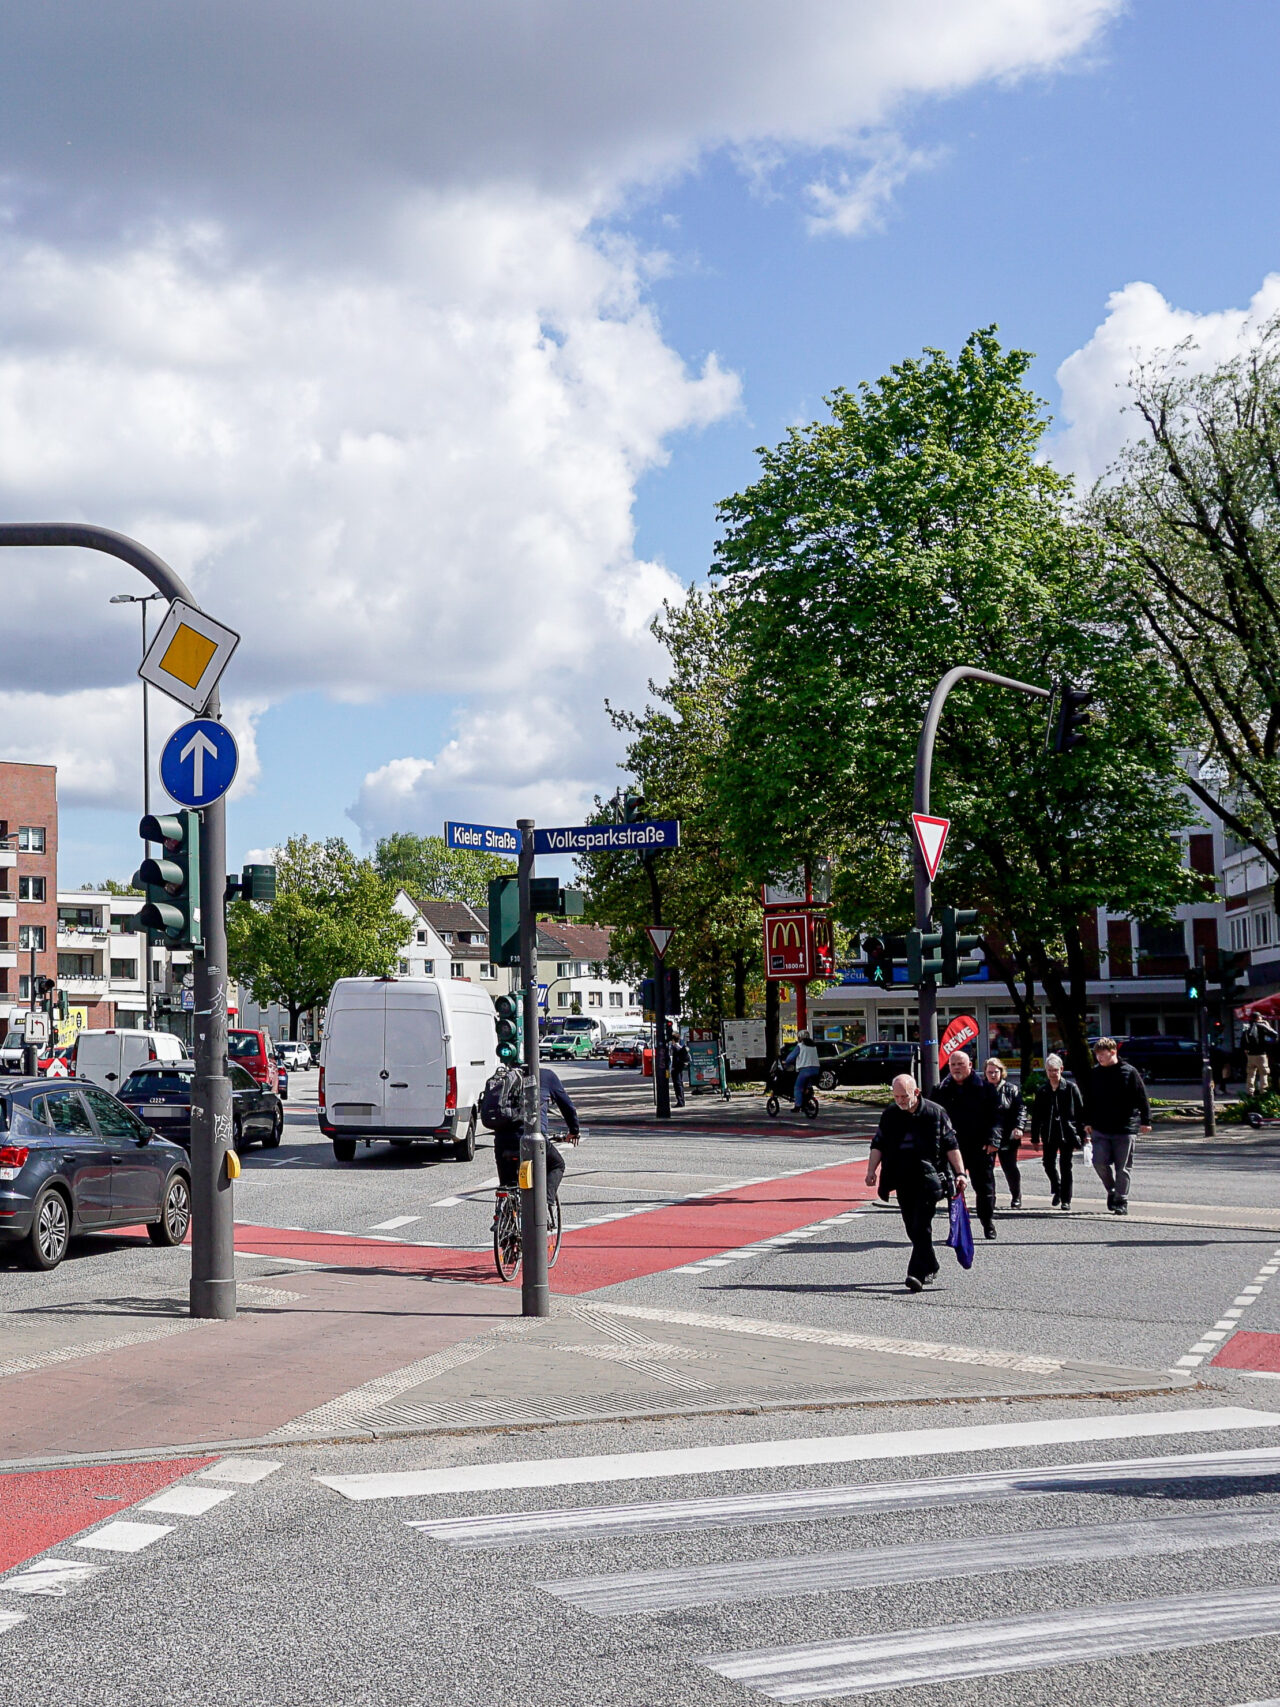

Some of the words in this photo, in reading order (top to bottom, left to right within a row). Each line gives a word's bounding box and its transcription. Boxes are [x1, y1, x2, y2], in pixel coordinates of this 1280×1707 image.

[454, 826, 483, 846] Kieler
[485, 830, 517, 850] Straße
[546, 826, 665, 851] Volksparkstraße
[943, 1026, 975, 1055] REWE
